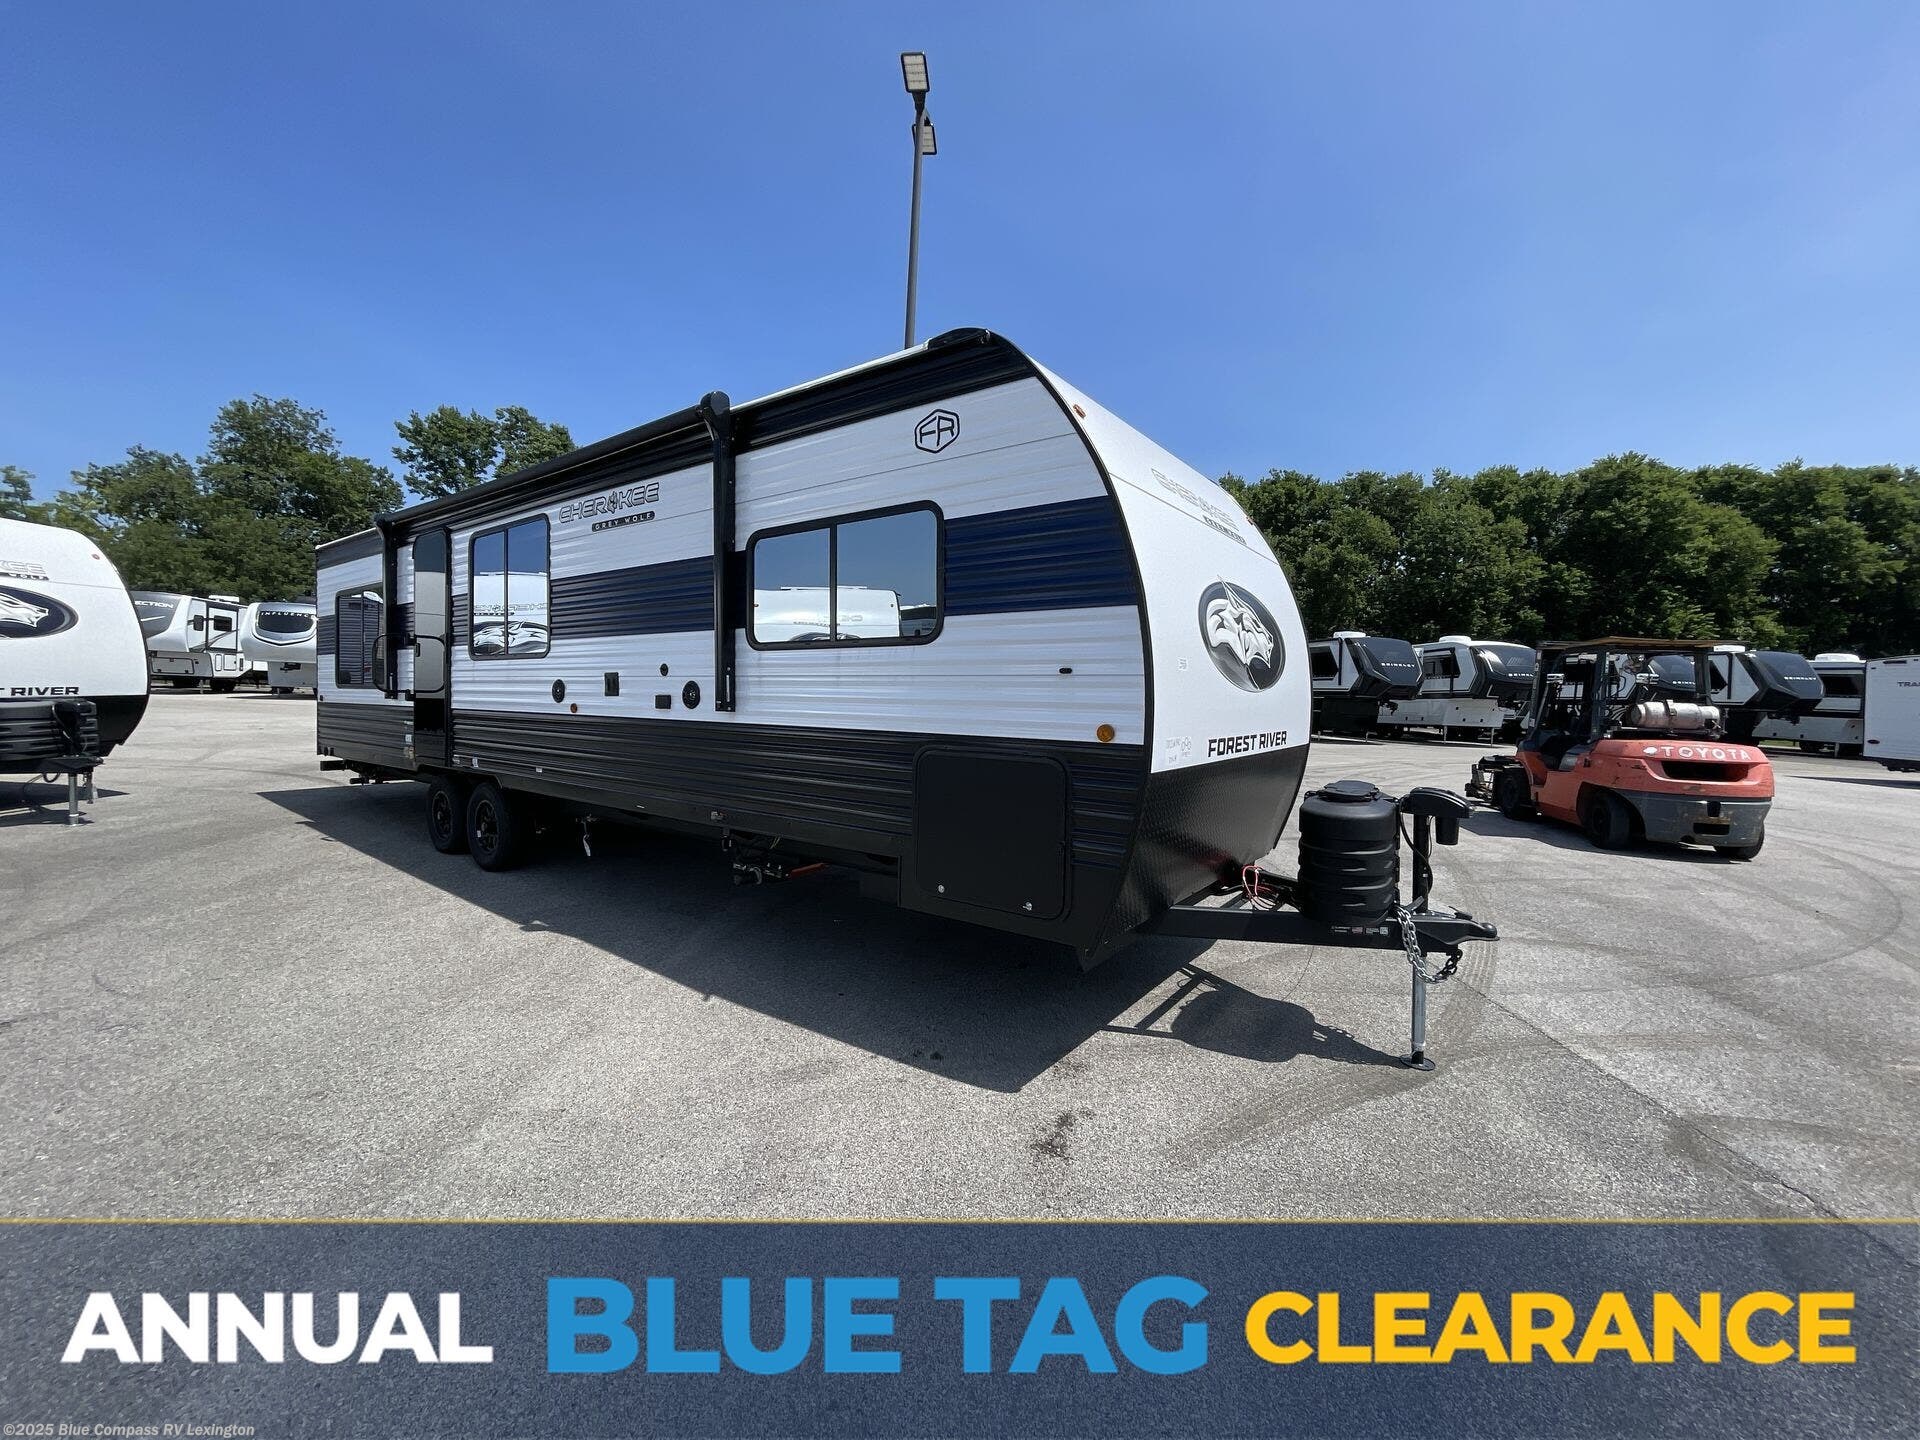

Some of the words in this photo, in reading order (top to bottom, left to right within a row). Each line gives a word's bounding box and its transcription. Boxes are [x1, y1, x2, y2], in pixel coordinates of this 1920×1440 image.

[560, 482, 660, 524] CHEROKEE
[595, 518, 620, 530] GREY
[624, 512, 652, 524] WOLF
[10, 686, 80, 696] RIVER
[1207, 734, 1258, 758] FOREST
[1258, 730, 1288, 750] RIVER
[1661, 746, 1752, 760] TOYOTA
